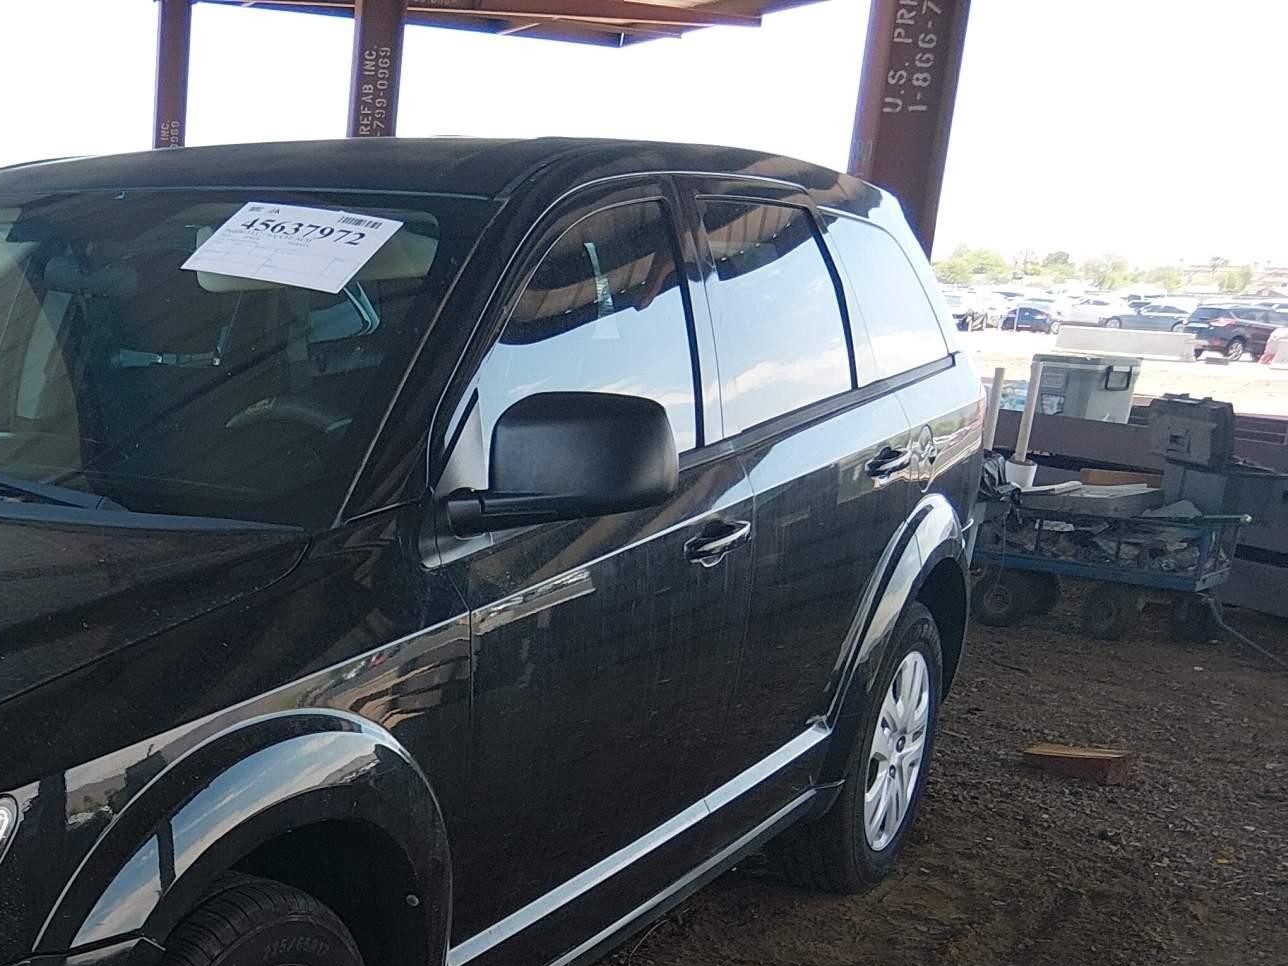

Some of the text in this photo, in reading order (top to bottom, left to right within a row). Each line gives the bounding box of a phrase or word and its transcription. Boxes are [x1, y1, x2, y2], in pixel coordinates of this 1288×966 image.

[362, 45, 377, 76] INC.
[883, 0, 918, 113] U.S. PR
[240, 217, 366, 246] 45637972
